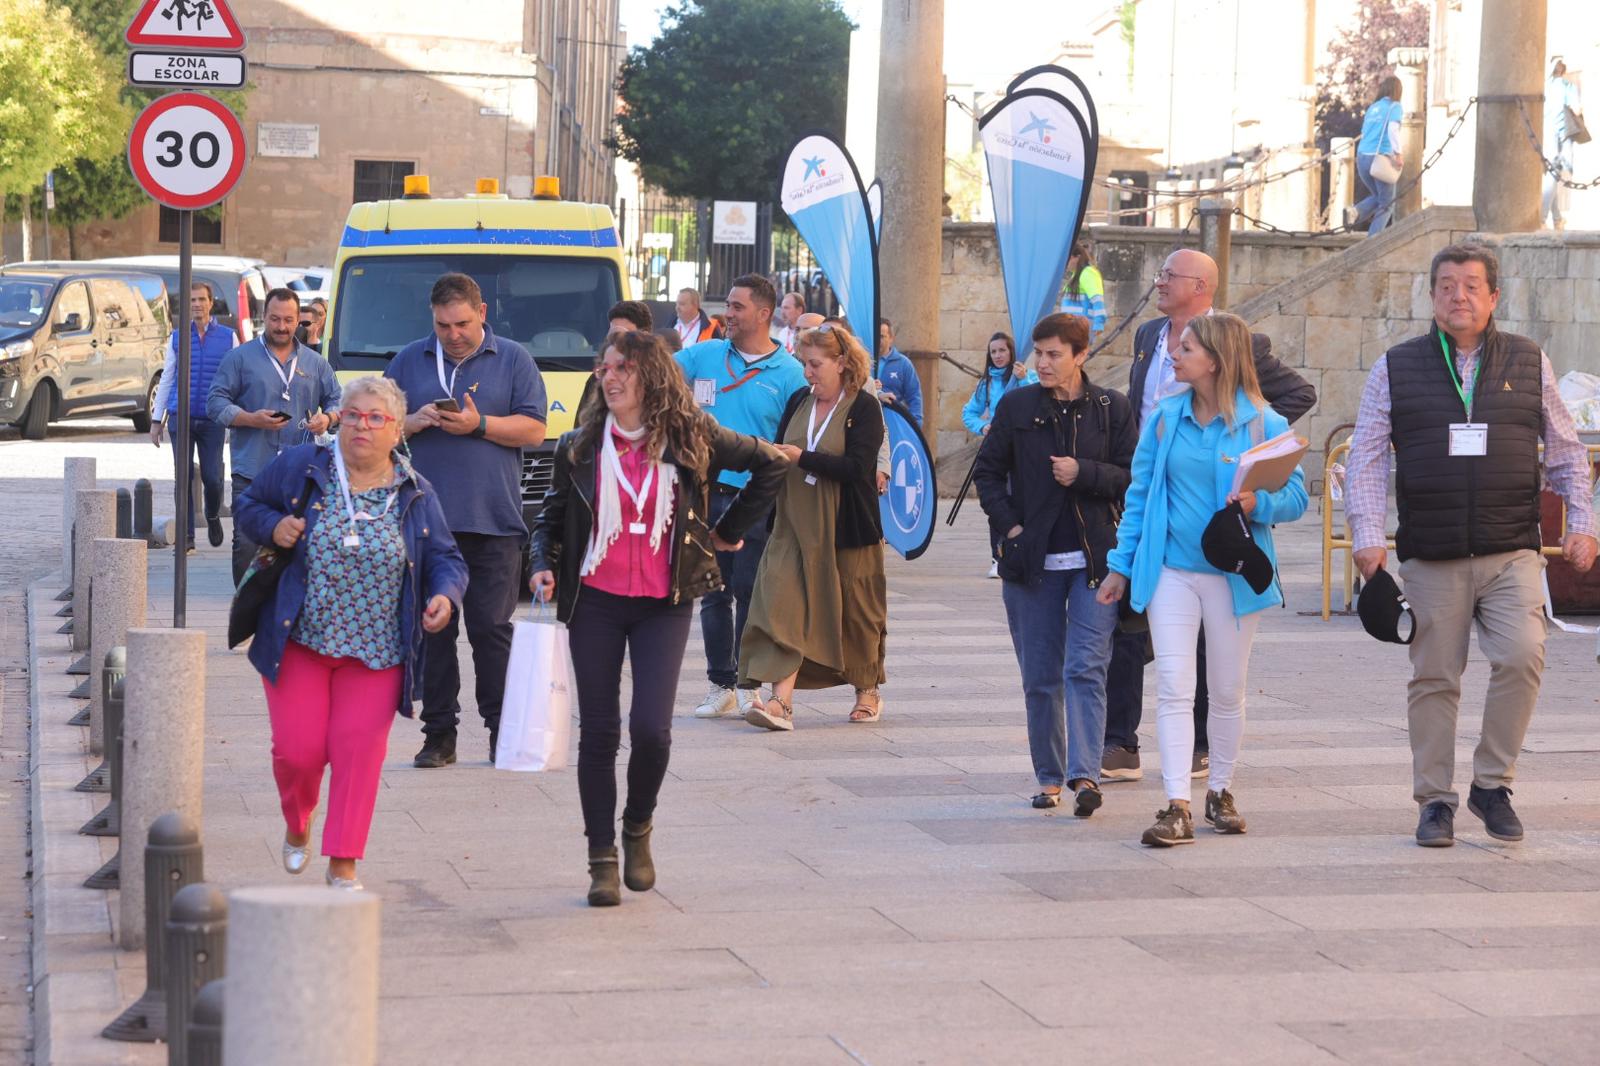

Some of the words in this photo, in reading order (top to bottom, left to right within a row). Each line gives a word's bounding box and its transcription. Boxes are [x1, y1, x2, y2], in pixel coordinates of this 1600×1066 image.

[168, 57, 207, 68] ZONA
[154, 69, 219, 81] ESCOLAR
[155, 130, 220, 169] 30
